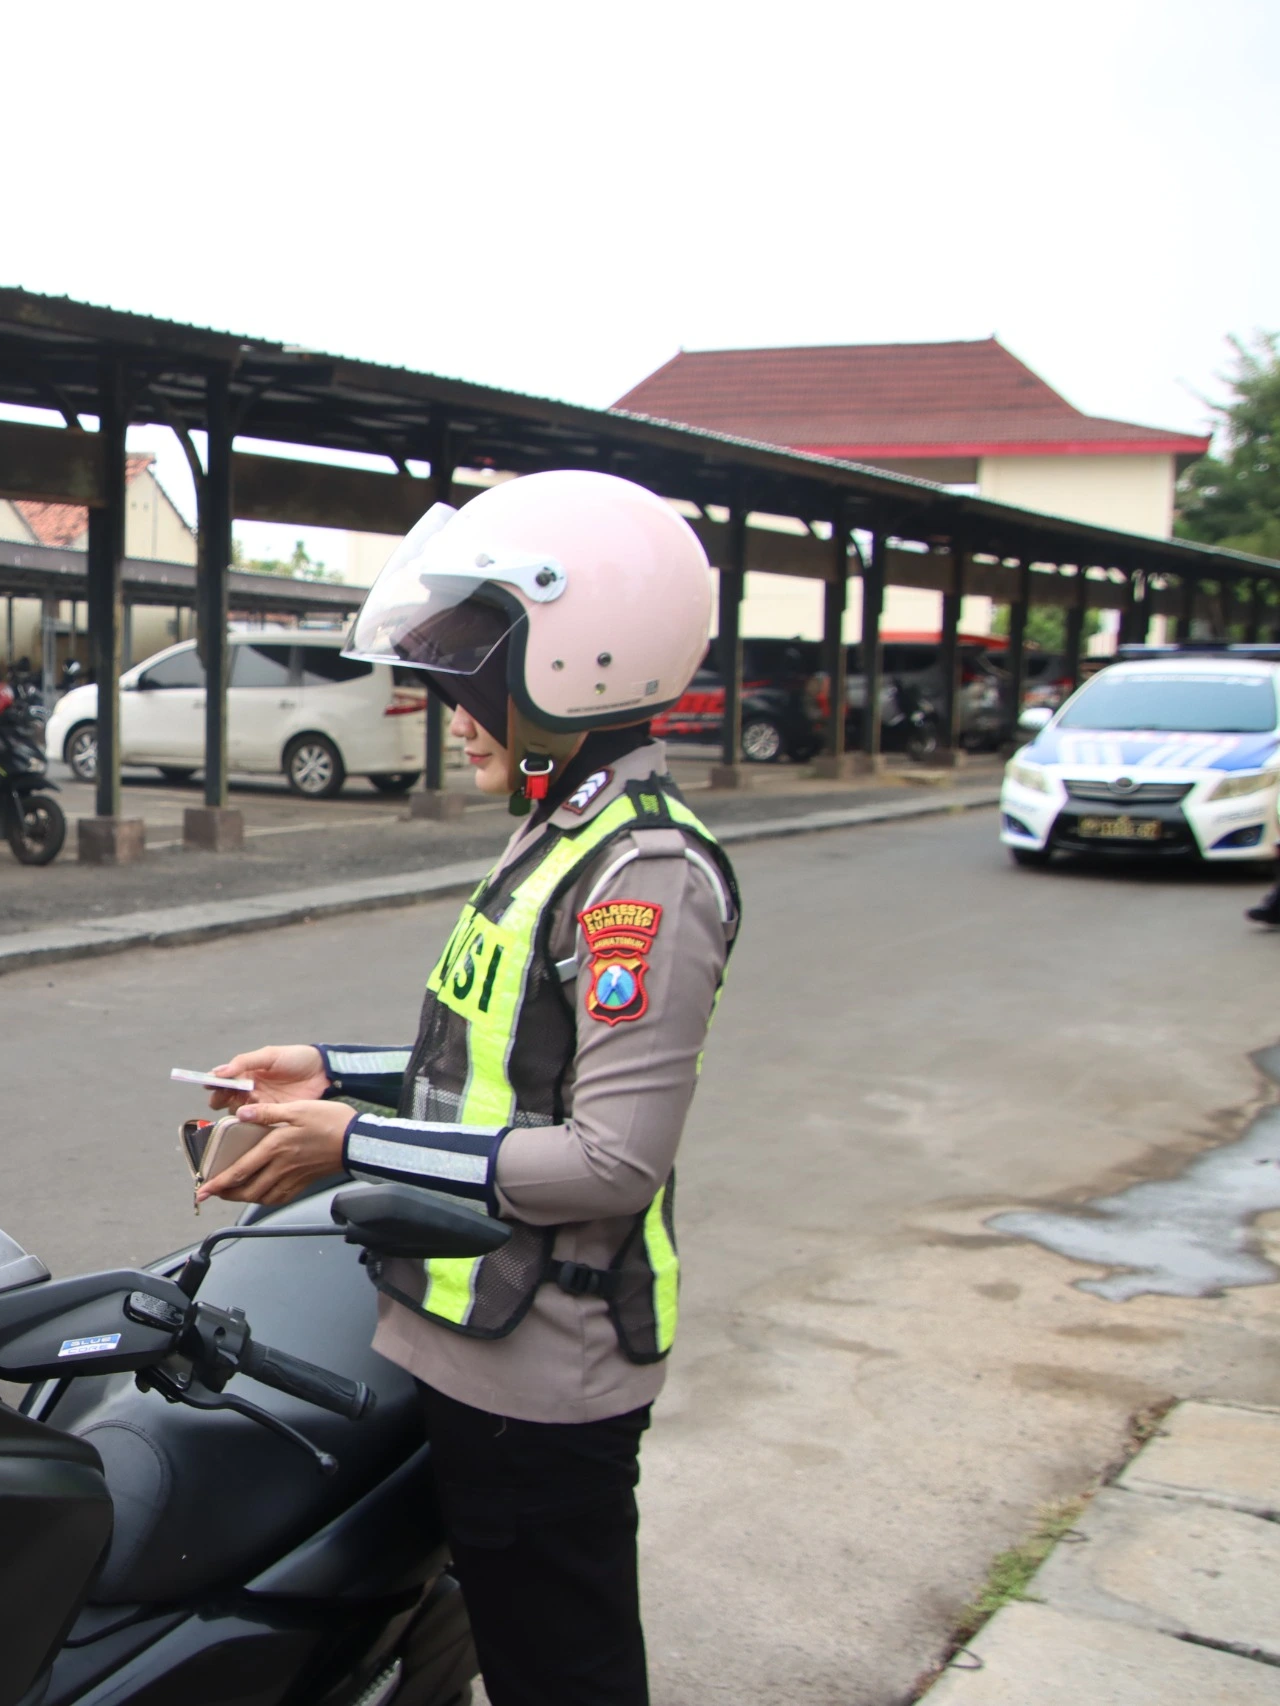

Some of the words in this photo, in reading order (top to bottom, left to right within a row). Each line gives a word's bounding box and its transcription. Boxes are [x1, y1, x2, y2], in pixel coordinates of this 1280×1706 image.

[583, 903, 654, 925] POLRESTA
[587, 914, 652, 935] SUMENEP
[68, 1344, 109, 1354] CORE
[70, 1336, 112, 1347] BLUE
